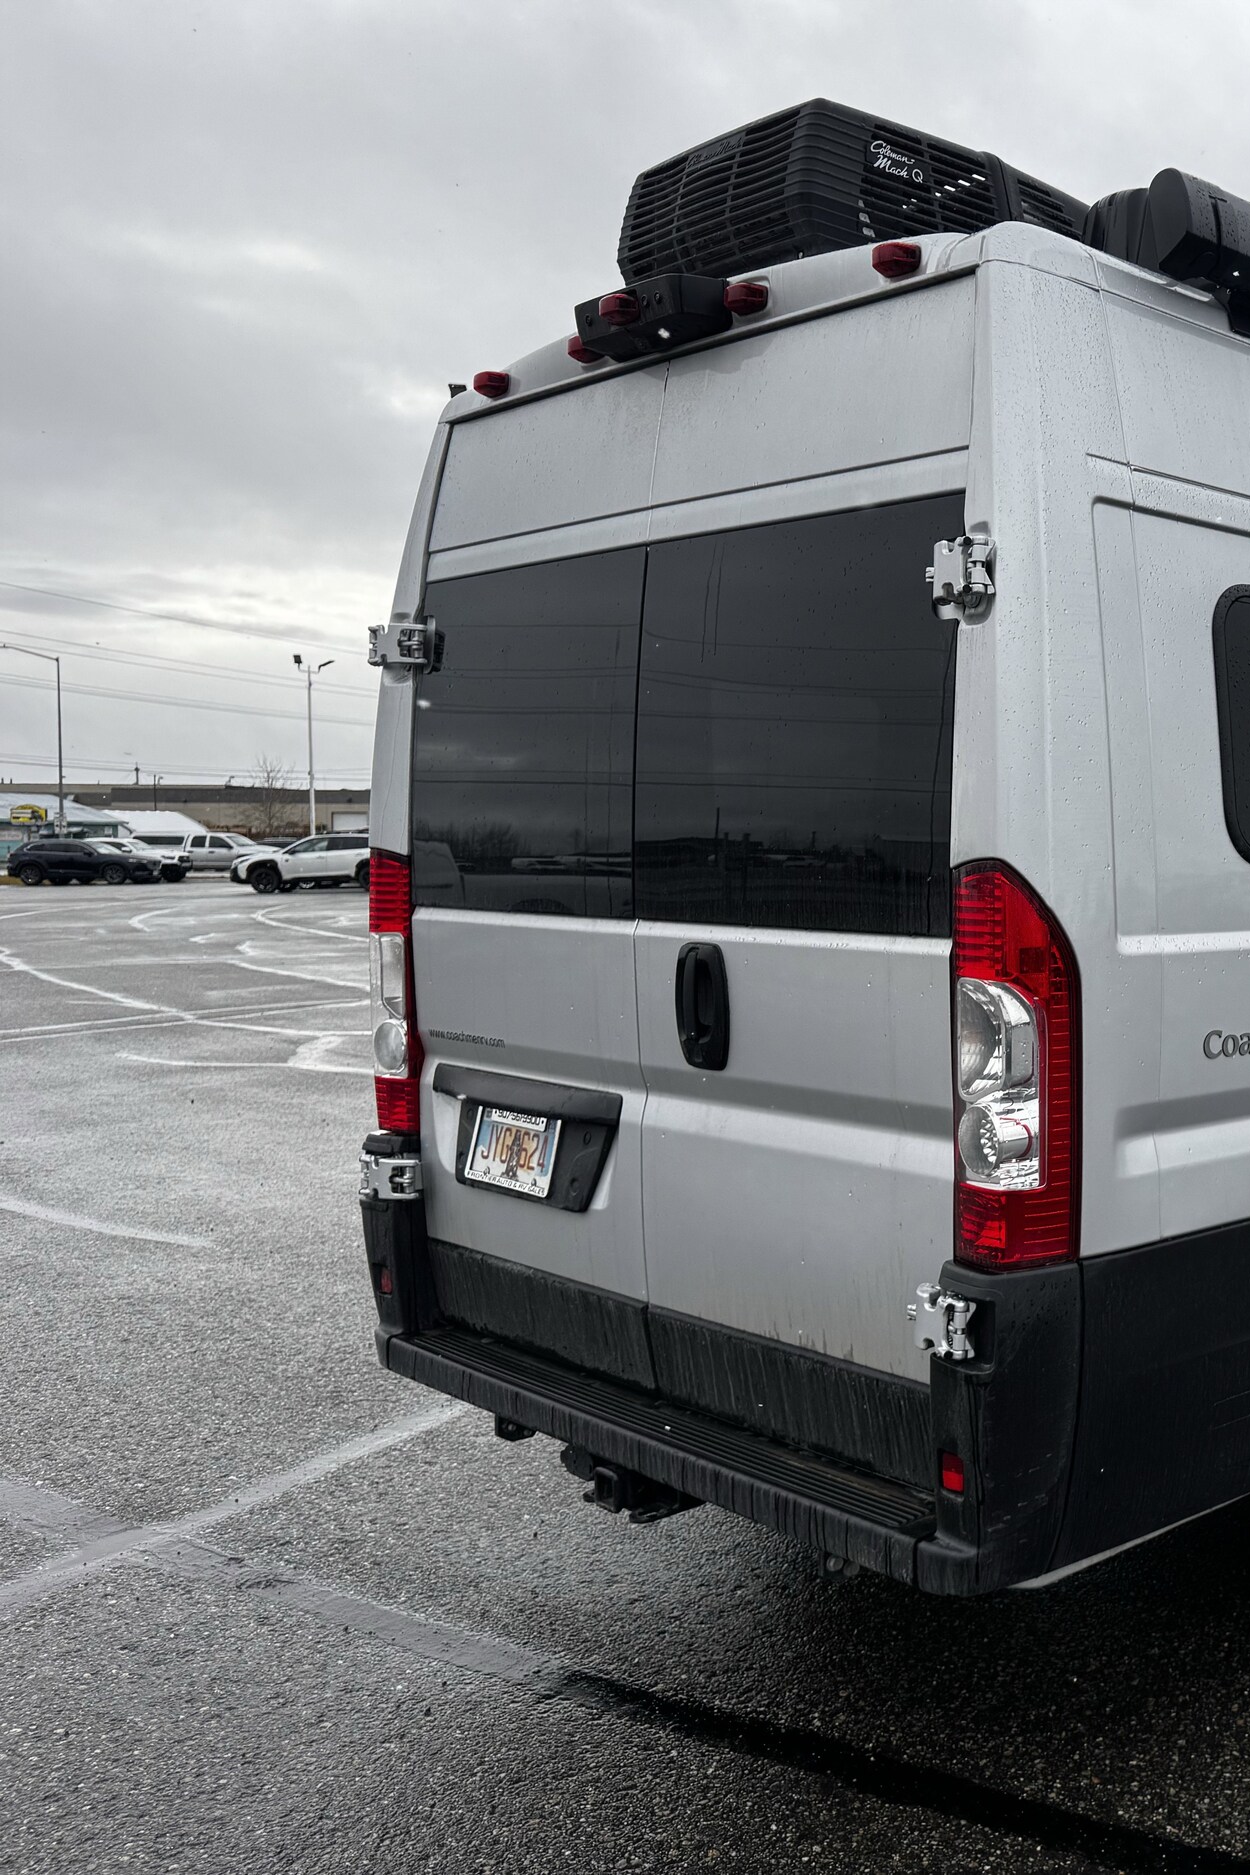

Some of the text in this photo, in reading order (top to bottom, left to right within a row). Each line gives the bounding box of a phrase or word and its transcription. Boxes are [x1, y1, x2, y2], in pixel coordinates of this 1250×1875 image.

[870, 140, 915, 165] Coleman
[873, 154, 924, 184] Mach Q
[497, 1176, 512, 1187] AUTO
